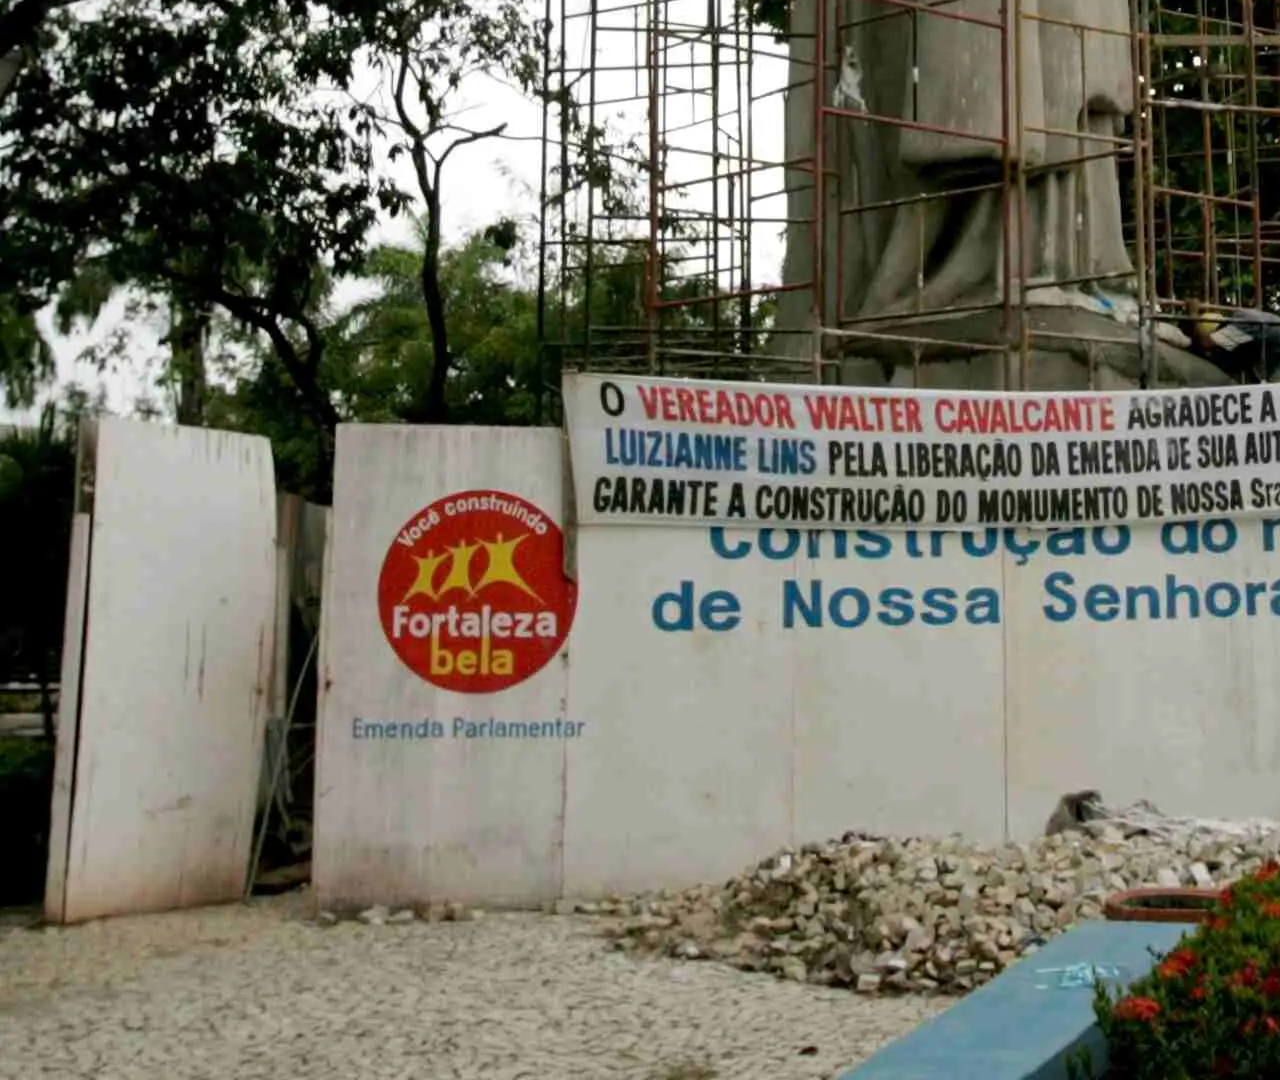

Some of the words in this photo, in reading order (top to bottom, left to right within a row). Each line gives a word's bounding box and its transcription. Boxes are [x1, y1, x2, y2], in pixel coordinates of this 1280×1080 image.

[600, 381, 625, 417] O
[637, 384, 796, 430] VEREADOR
[804, 394, 924, 433] WALTER
[935, 397, 1116, 434] CAVALCANTE
[1127, 392, 1252, 431] AGRADECE
[1260, 390, 1278, 422] A
[605, 427, 747, 471] LUIZIANNE
[758, 438, 816, 475] LINS
[828, 440, 889, 478] PELA
[895, 438, 1022, 481] LIBERAÇÃO
[1031, 442, 1061, 476] DA
[1067, 437, 1161, 476] EMENDA
[1166, 436, 1191, 471] DE
[1197, 433, 1239, 469] SUA
[397, 509, 441, 548] Você
[444, 494, 549, 536] construindo
[593, 476, 718, 517] GARANTE
[727, 482, 746, 518] A
[755, 484, 925, 524] CONSTRUÇÃO
[936, 488, 967, 524] DO
[977, 486, 1128, 524] MONUMENTO
[1136, 484, 1164, 519] DE
[1170, 479, 1244, 516] NOSSA
[1161, 517, 1238, 554] do
[391, 604, 558, 639] Fortaleza
[652, 580, 742, 631] de
[783, 580, 1001, 628] Nossa
[430, 634, 515, 675] bela
[352, 717, 444, 740] Emenda
[453, 716, 586, 739] Parlamentar
